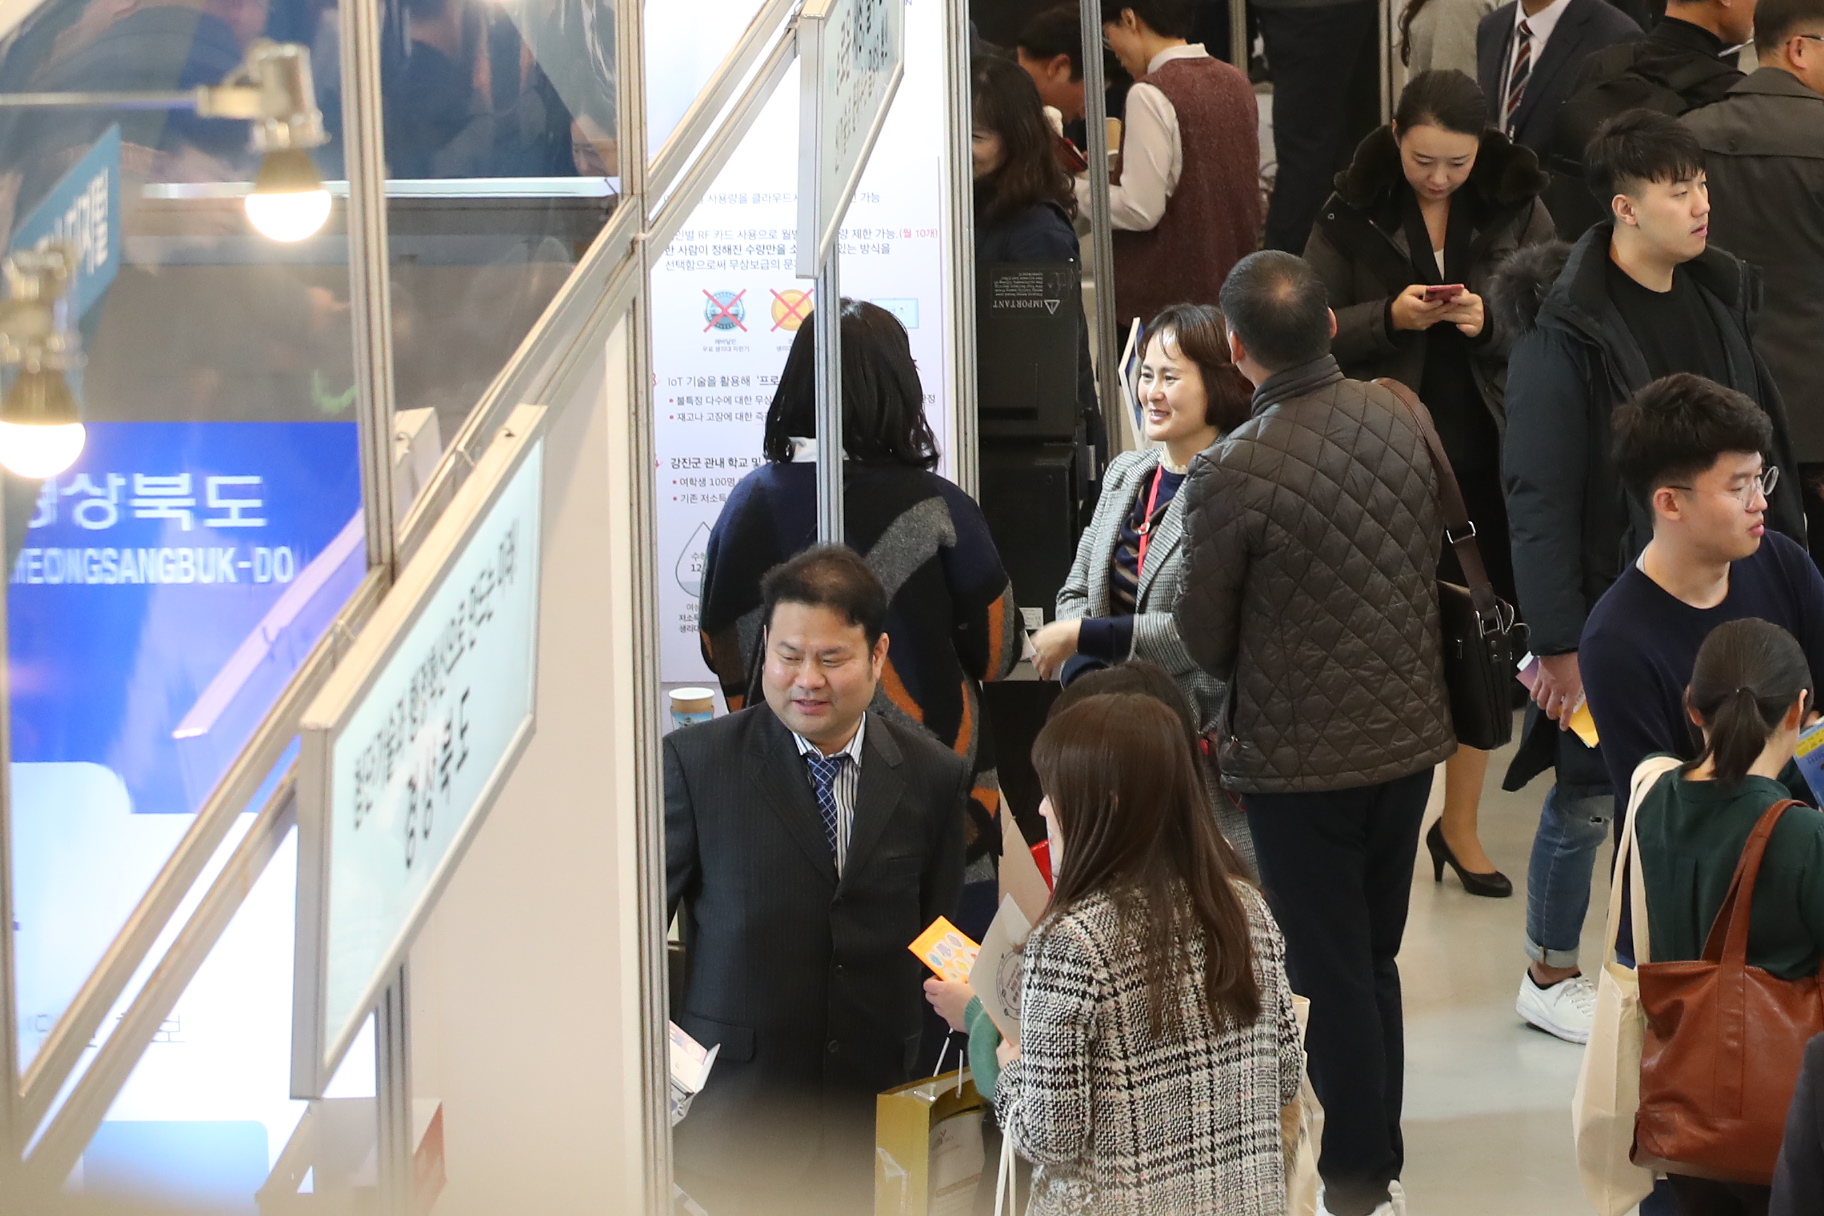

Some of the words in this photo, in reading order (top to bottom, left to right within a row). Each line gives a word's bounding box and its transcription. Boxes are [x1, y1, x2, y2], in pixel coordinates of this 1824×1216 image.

[714, 229, 733, 240] 카드
[737, 229, 778, 240] 사용으로
[852, 228, 872, 240] 제한
[680, 244, 709, 255] 사람이
[712, 244, 742, 255] 정해진
[860, 243, 890, 255] 방식을
[665, 260, 727, 271] 선택함으로써
[729, 259, 780, 271] 무상보급의
[993, 299, 1043, 309] IMPORTANT
[687, 376, 716, 387] 기술을
[677, 396, 703, 407] 불특정
[706, 395, 732, 406] 다수에
[735, 395, 752, 406] 대한
[677, 412, 705, 423] 재고나
[708, 412, 734, 423] 고장에
[735, 412, 752, 423] 대한
[670, 457, 701, 469] 강진군
[704, 457, 725, 469] 관내
[729, 457, 749, 469] 학교
[680, 477, 707, 487] 여학생
[681, 493, 698, 504] 기존
